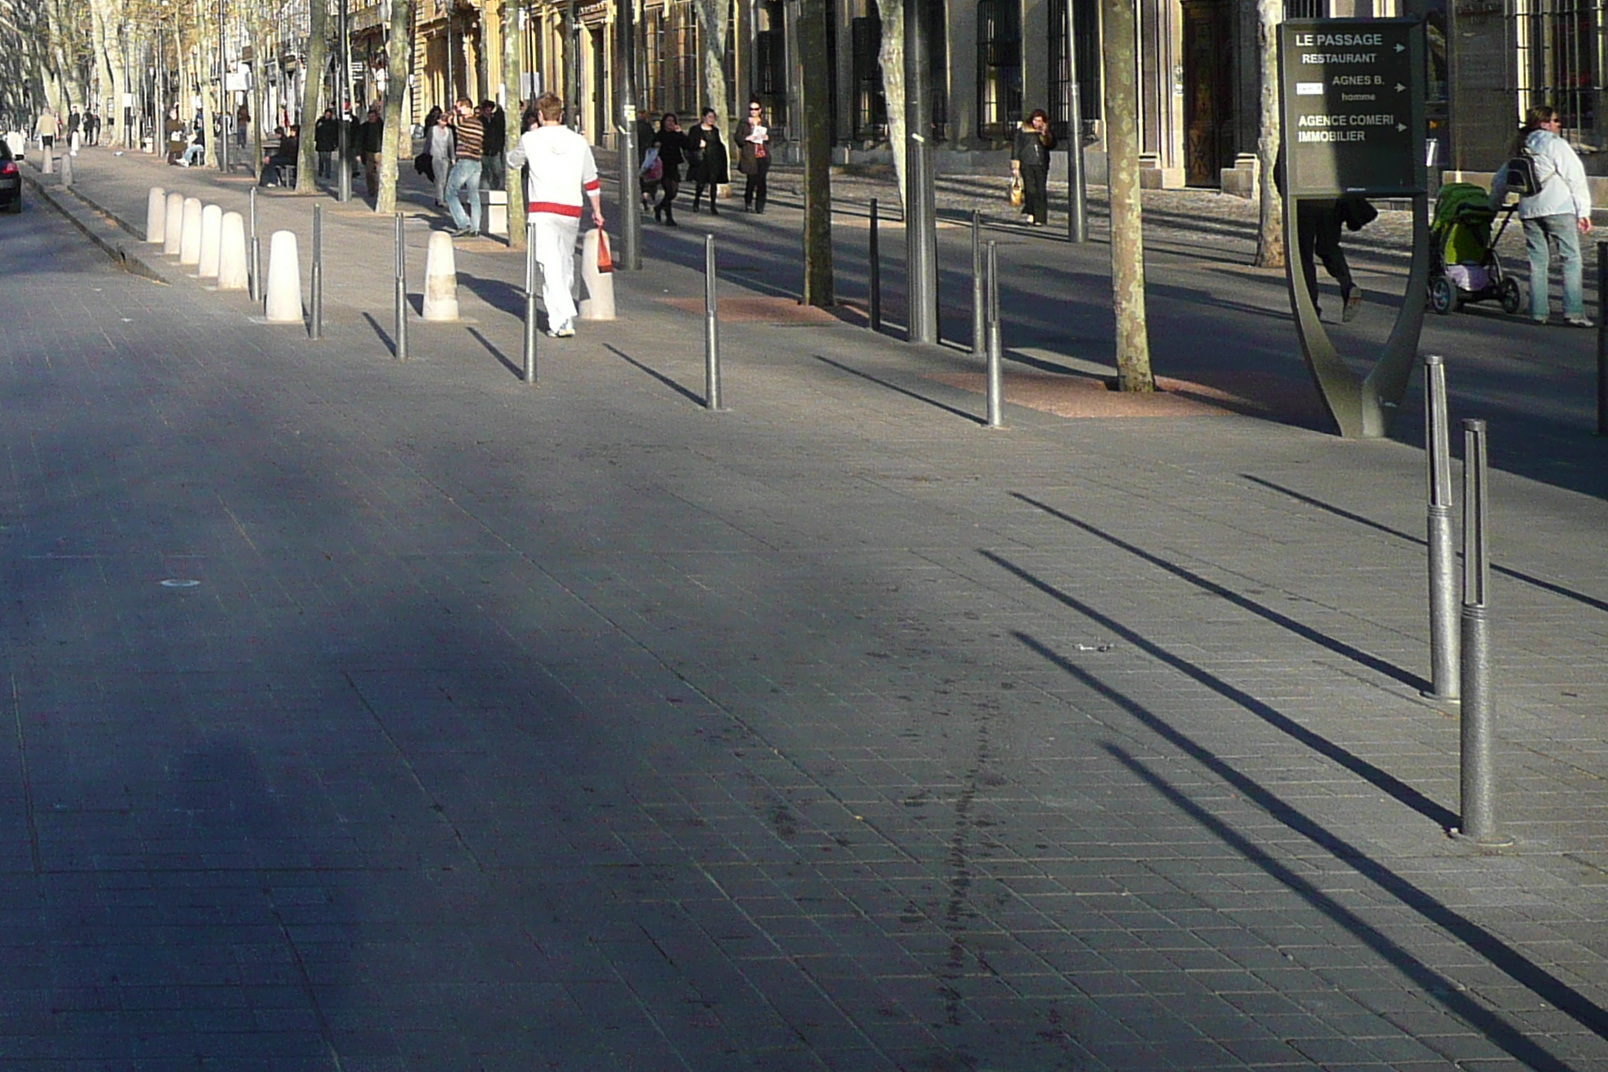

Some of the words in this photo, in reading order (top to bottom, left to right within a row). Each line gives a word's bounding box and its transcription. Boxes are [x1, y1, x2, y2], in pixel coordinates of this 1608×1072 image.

[1296, 35, 1313, 46] LE
[1317, 34, 1383, 46] PASSAGE
[1302, 53, 1377, 64] RESTAURANT
[1332, 75, 1371, 86] AGNES
[1373, 76, 1385, 86] B.
[1341, 92, 1376, 101] homme
[1298, 115, 1347, 127] AGENCE
[1349, 114, 1394, 126] COMERI
[1298, 131, 1365, 142] IMMOBILIER
